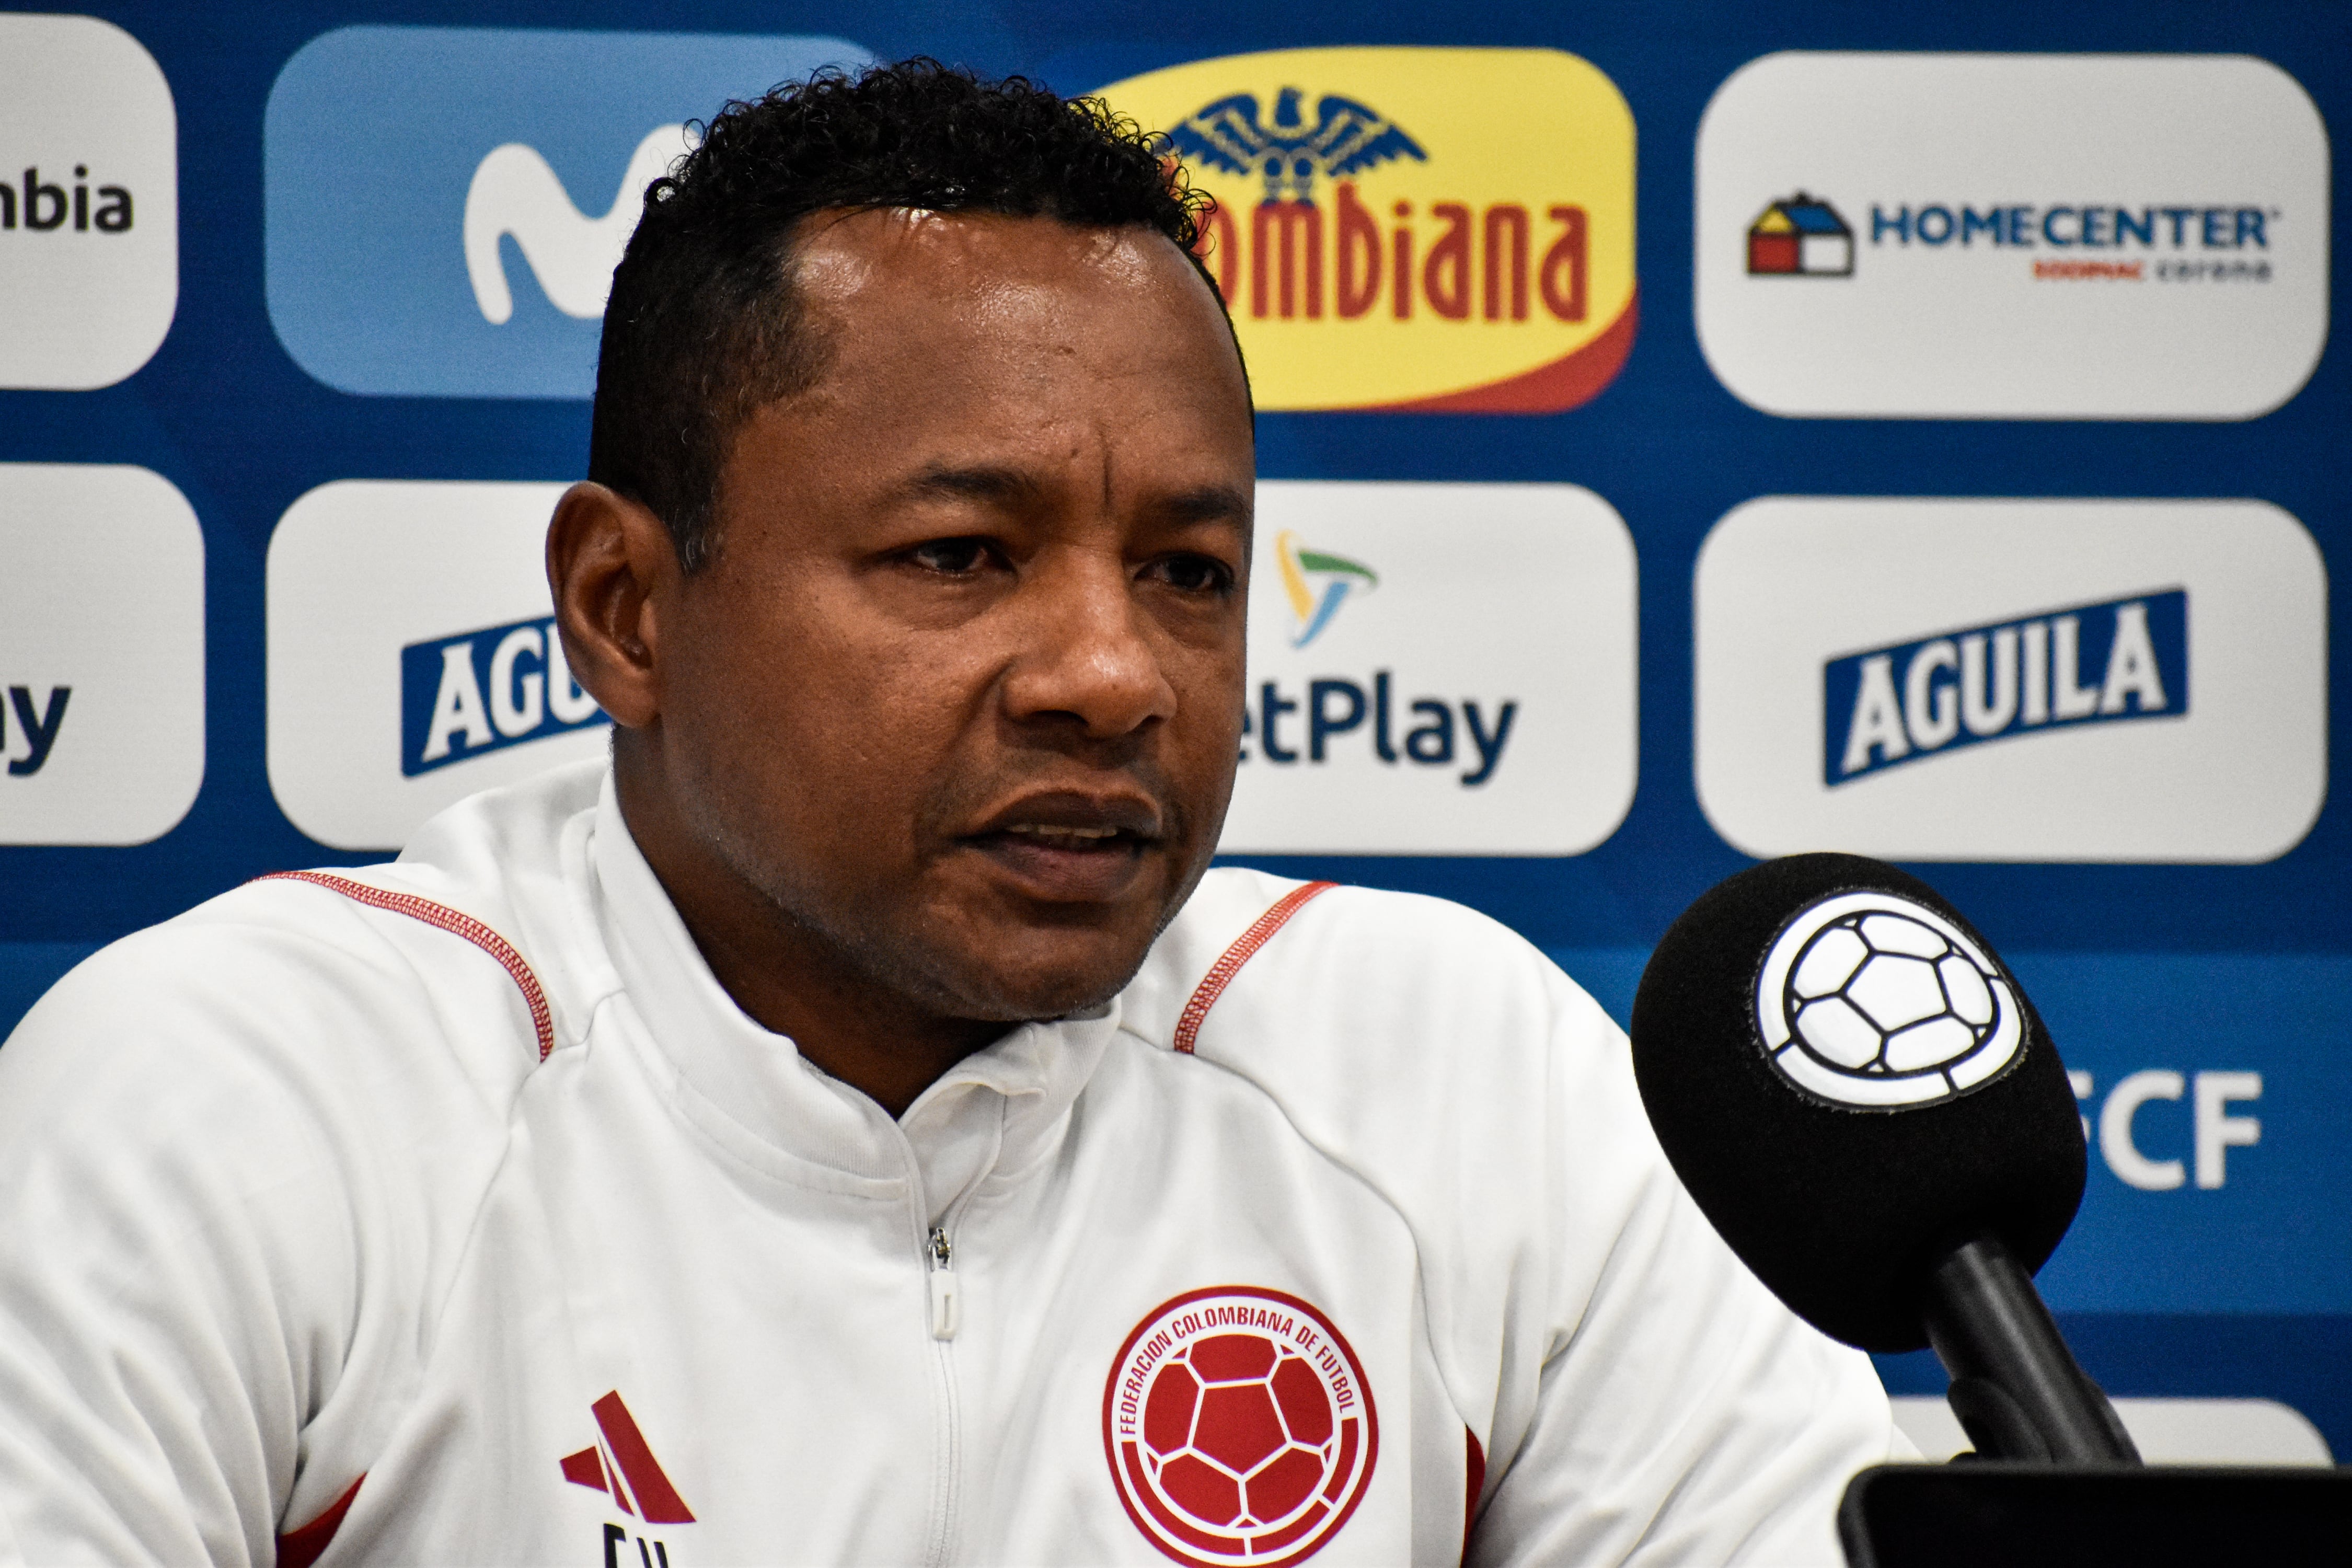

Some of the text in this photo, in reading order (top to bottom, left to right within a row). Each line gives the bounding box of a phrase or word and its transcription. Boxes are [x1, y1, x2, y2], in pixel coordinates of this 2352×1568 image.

[1165, 180, 1588, 321] ombiana
[1871, 204, 2268, 246] HOMECENTER
[1239, 671, 1517, 787] tPlay
[1841, 602, 2167, 775] AGUILA
[1120, 1306, 1355, 1434] FEDERACION COLOMBIANA DE FUTBOL
